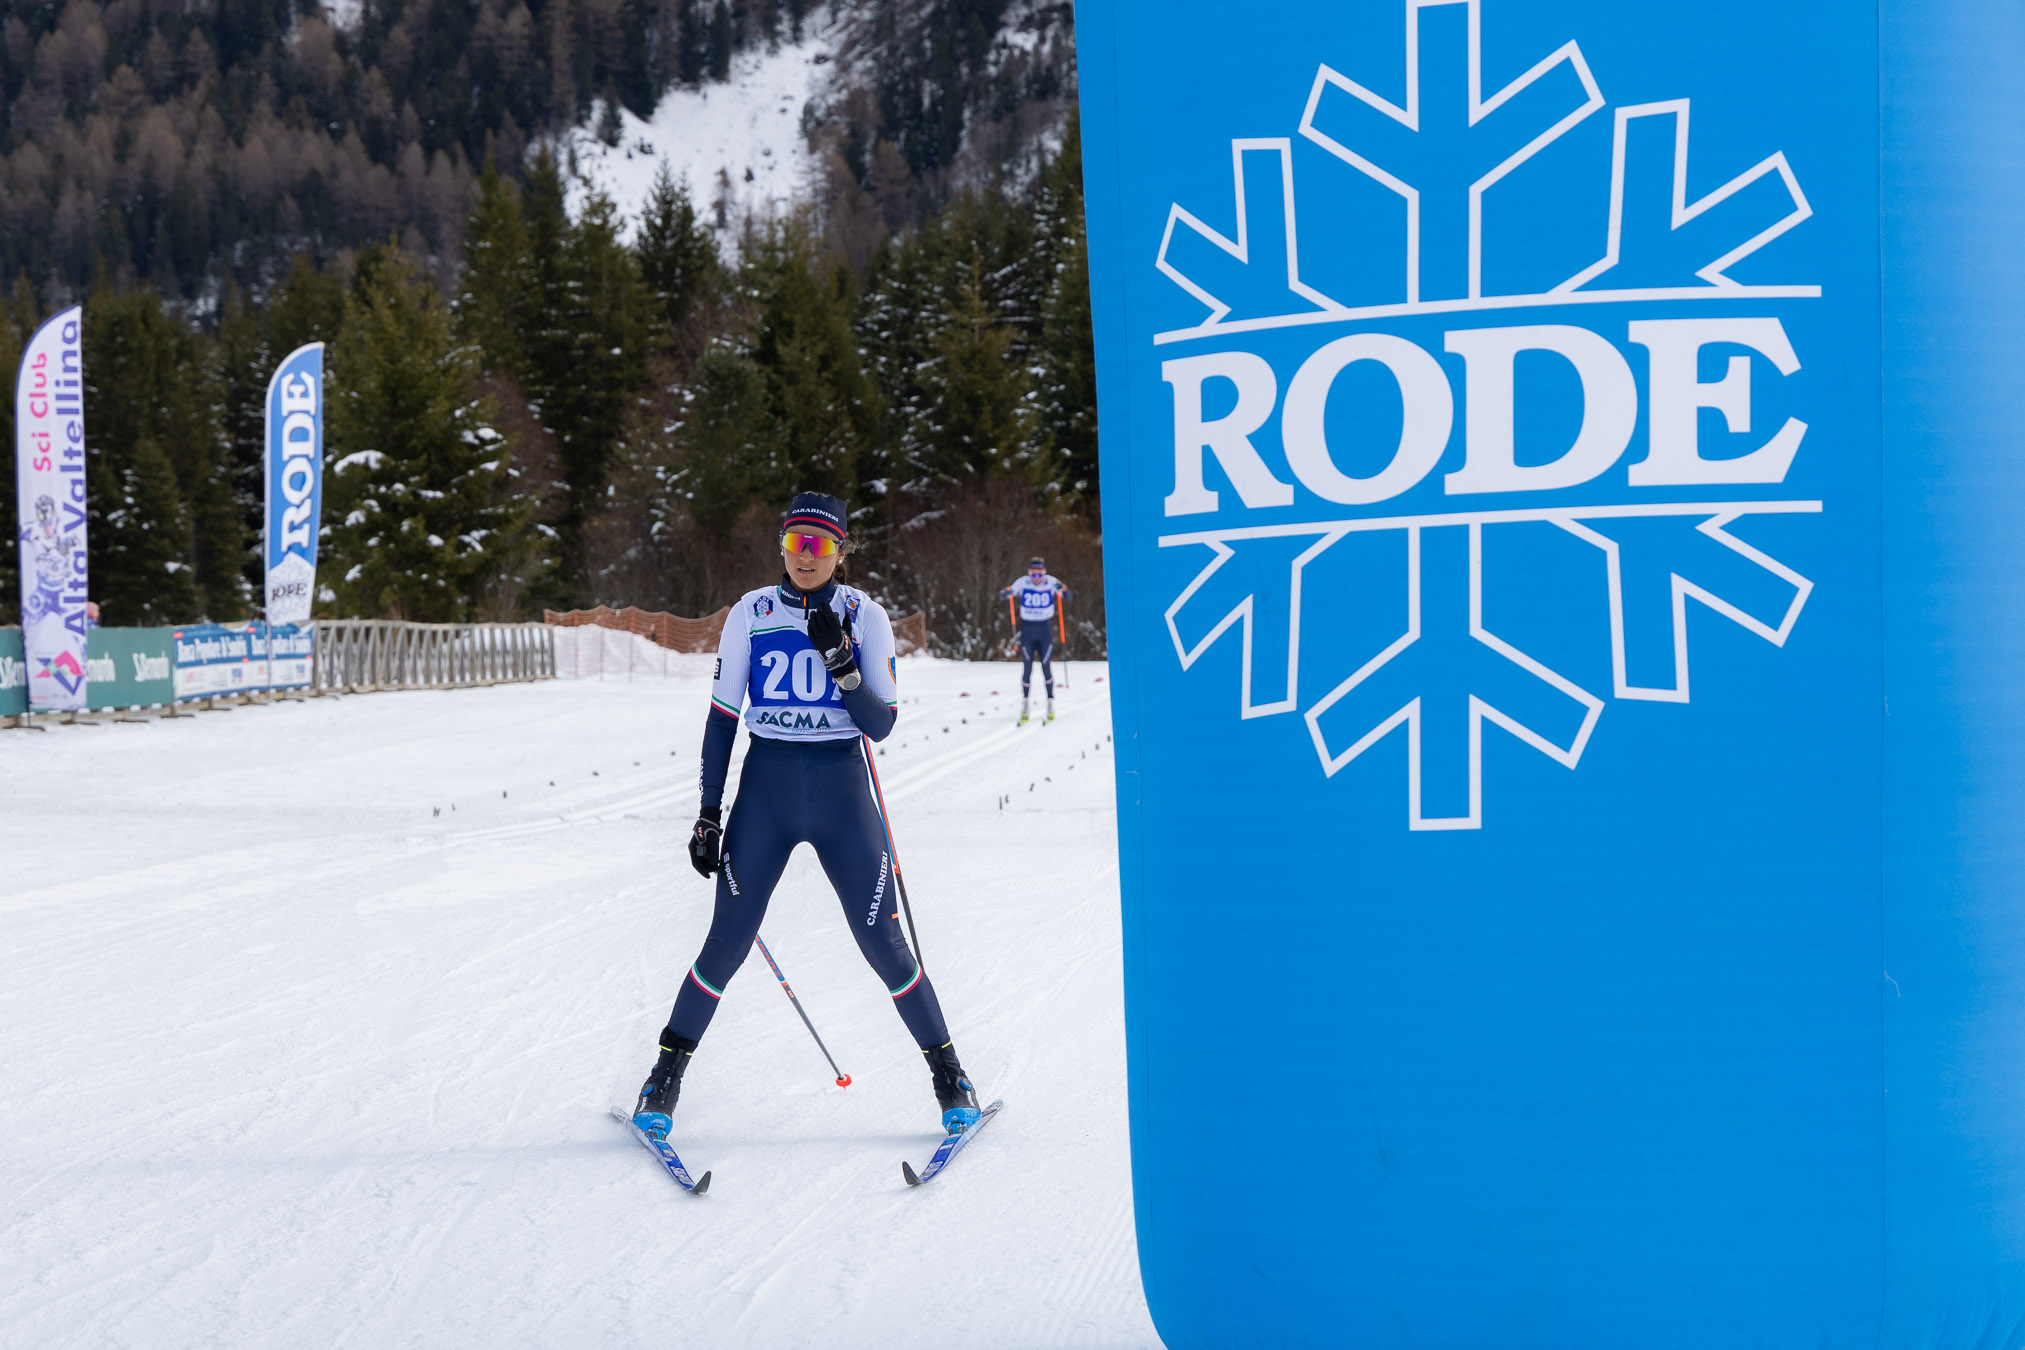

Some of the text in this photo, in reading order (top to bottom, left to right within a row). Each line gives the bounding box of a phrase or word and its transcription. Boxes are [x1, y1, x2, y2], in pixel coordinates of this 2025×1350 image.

[29, 352, 51, 472] Sci Club
[1161, 317, 1808, 517] RODE
[55, 320, 87, 637] Alta Valtellina
[281, 371, 316, 552] RODE
[792, 508, 839, 522] CARABINIERI
[1023, 592, 1050, 607] 209
[761, 648, 842, 702] 20
[756, 711, 831, 728] SACMA
[724, 863, 740, 896] sportful
[866, 850, 888, 926] CARABINIERI
